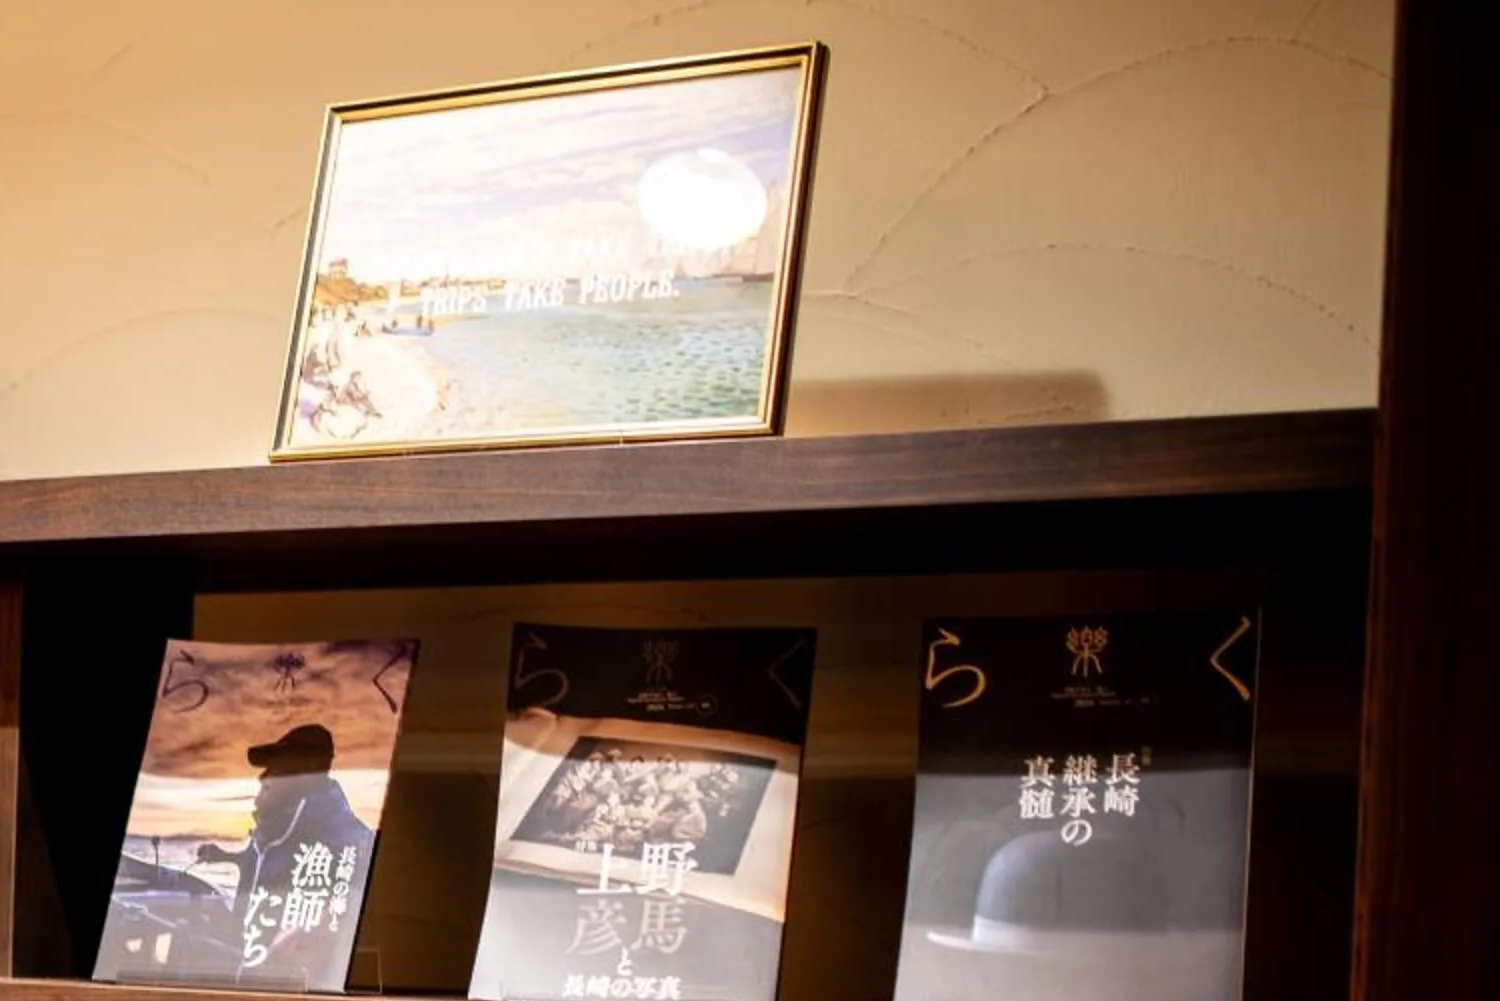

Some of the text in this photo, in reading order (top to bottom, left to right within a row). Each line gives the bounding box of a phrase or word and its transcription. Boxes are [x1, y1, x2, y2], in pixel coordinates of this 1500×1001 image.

[421, 284, 487, 314] TRIPS
[504, 277, 567, 310] TAKE
[1102, 753, 1141, 817] 長崎
